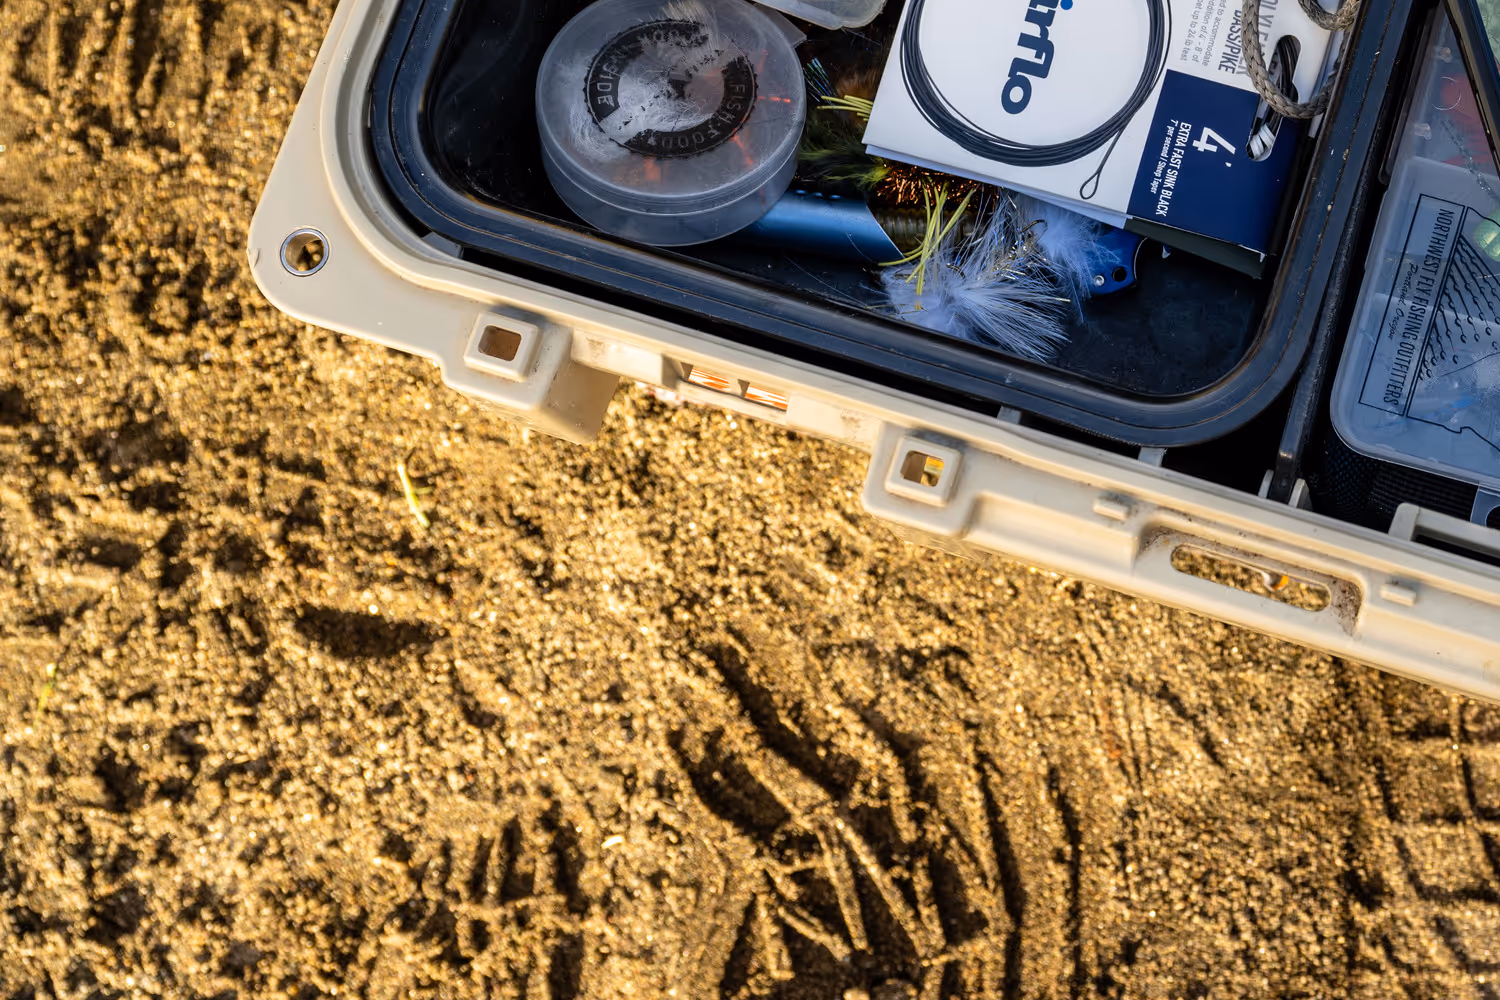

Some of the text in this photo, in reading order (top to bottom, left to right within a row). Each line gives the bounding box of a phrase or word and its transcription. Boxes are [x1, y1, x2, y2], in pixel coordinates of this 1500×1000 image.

[1191, 10, 1201, 20] up
[1202, 16, 1222, 67] accommodate
[1160, 136, 1172, 158] second
[1166, 125, 1175, 137] per
[1155, 121, 1192, 217] EXTRA FAST SINK BLACK
[1383, 208, 1455, 407] NORTHWEST FLY FISHING OUTFITTERS
